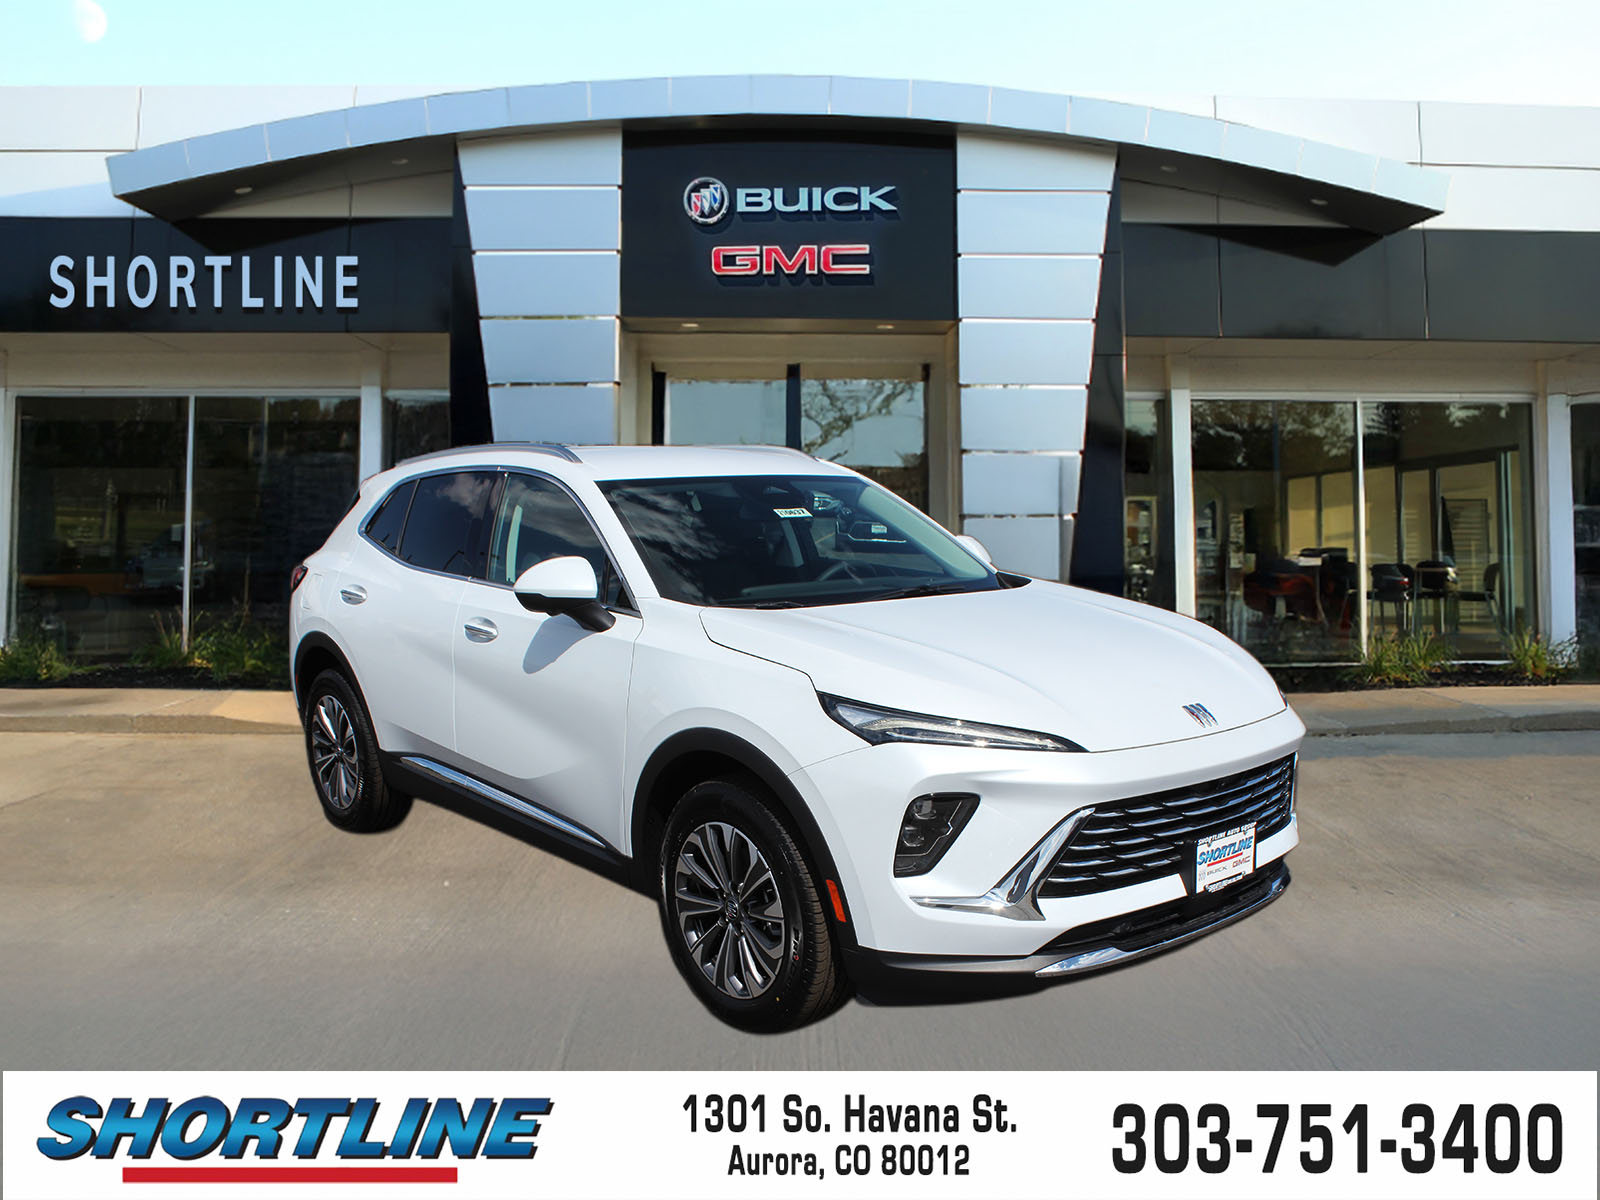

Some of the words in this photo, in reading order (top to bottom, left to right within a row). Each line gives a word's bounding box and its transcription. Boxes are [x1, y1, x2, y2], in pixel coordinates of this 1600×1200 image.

[736, 186, 898, 212] BUICK
[711, 244, 870, 275] GMC
[49, 255, 359, 308] SHORTLINE
[1197, 836, 1254, 865] SHORTLINE
[1232, 855, 1251, 868] GMC
